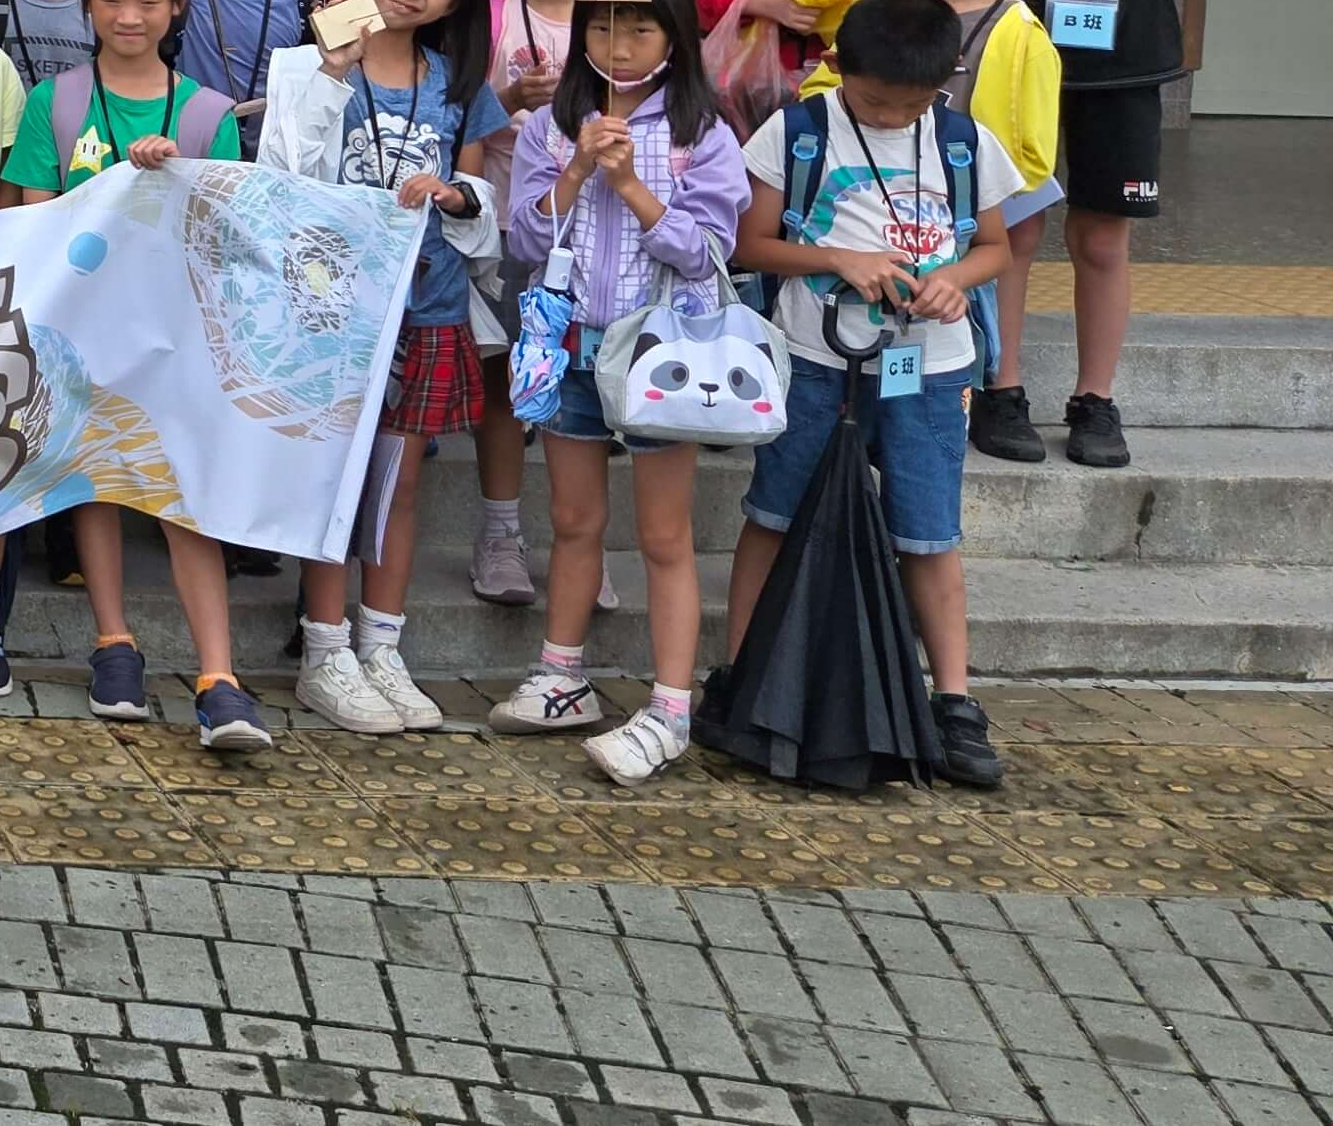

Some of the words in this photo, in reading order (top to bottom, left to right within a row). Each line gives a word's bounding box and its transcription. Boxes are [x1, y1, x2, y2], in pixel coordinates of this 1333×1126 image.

[1064, 15, 1077, 27] B
[1083, 14, 1103, 30] 班
[889, 362, 899, 376] C
[901, 356, 915, 376] 班
